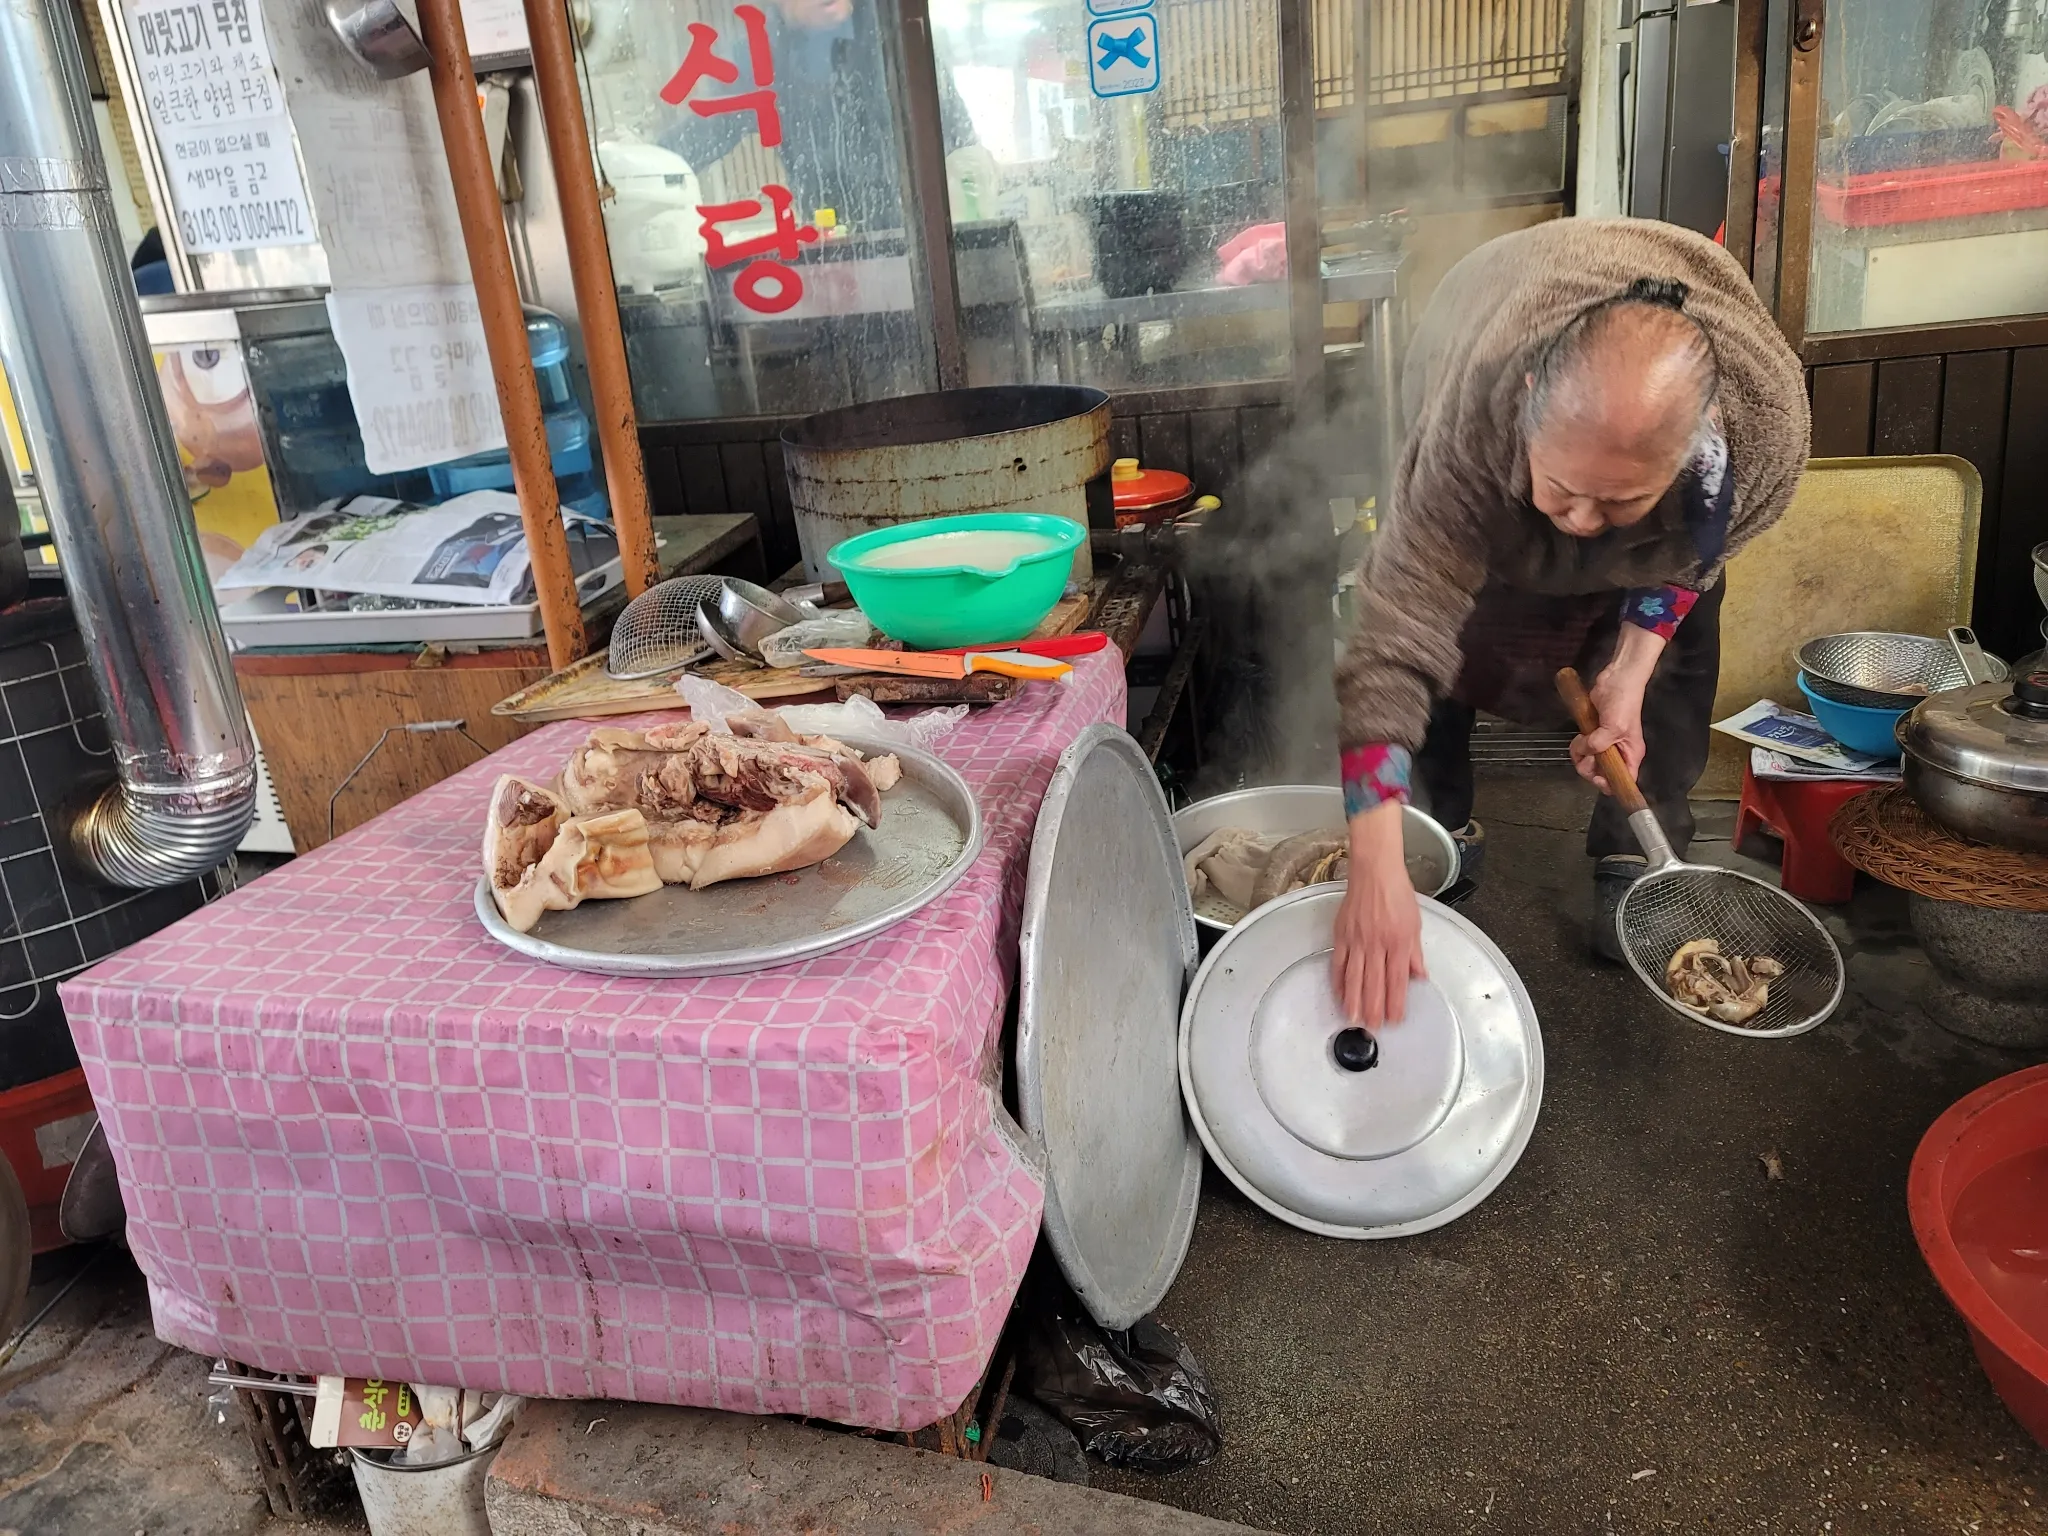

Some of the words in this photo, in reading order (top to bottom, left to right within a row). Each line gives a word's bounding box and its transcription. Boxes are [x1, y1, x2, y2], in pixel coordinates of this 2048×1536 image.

[138, 3, 211, 58] 머릿고기
[148, 55, 224, 86] 머릿고기와
[153, 85, 202, 125] 얼큰한
[203, 80, 236, 119] 양념
[241, 75, 273, 113] 무침
[256, 130, 271, 149] 때
[660, 4, 819, 314] 식당
[187, 166, 239, 198] 새마을
[244, 162, 268, 196] 금고
[182, 207, 221, 246] 3143
[219, 205, 242, 242] 09
[240, 198, 304, 240] 0064472
